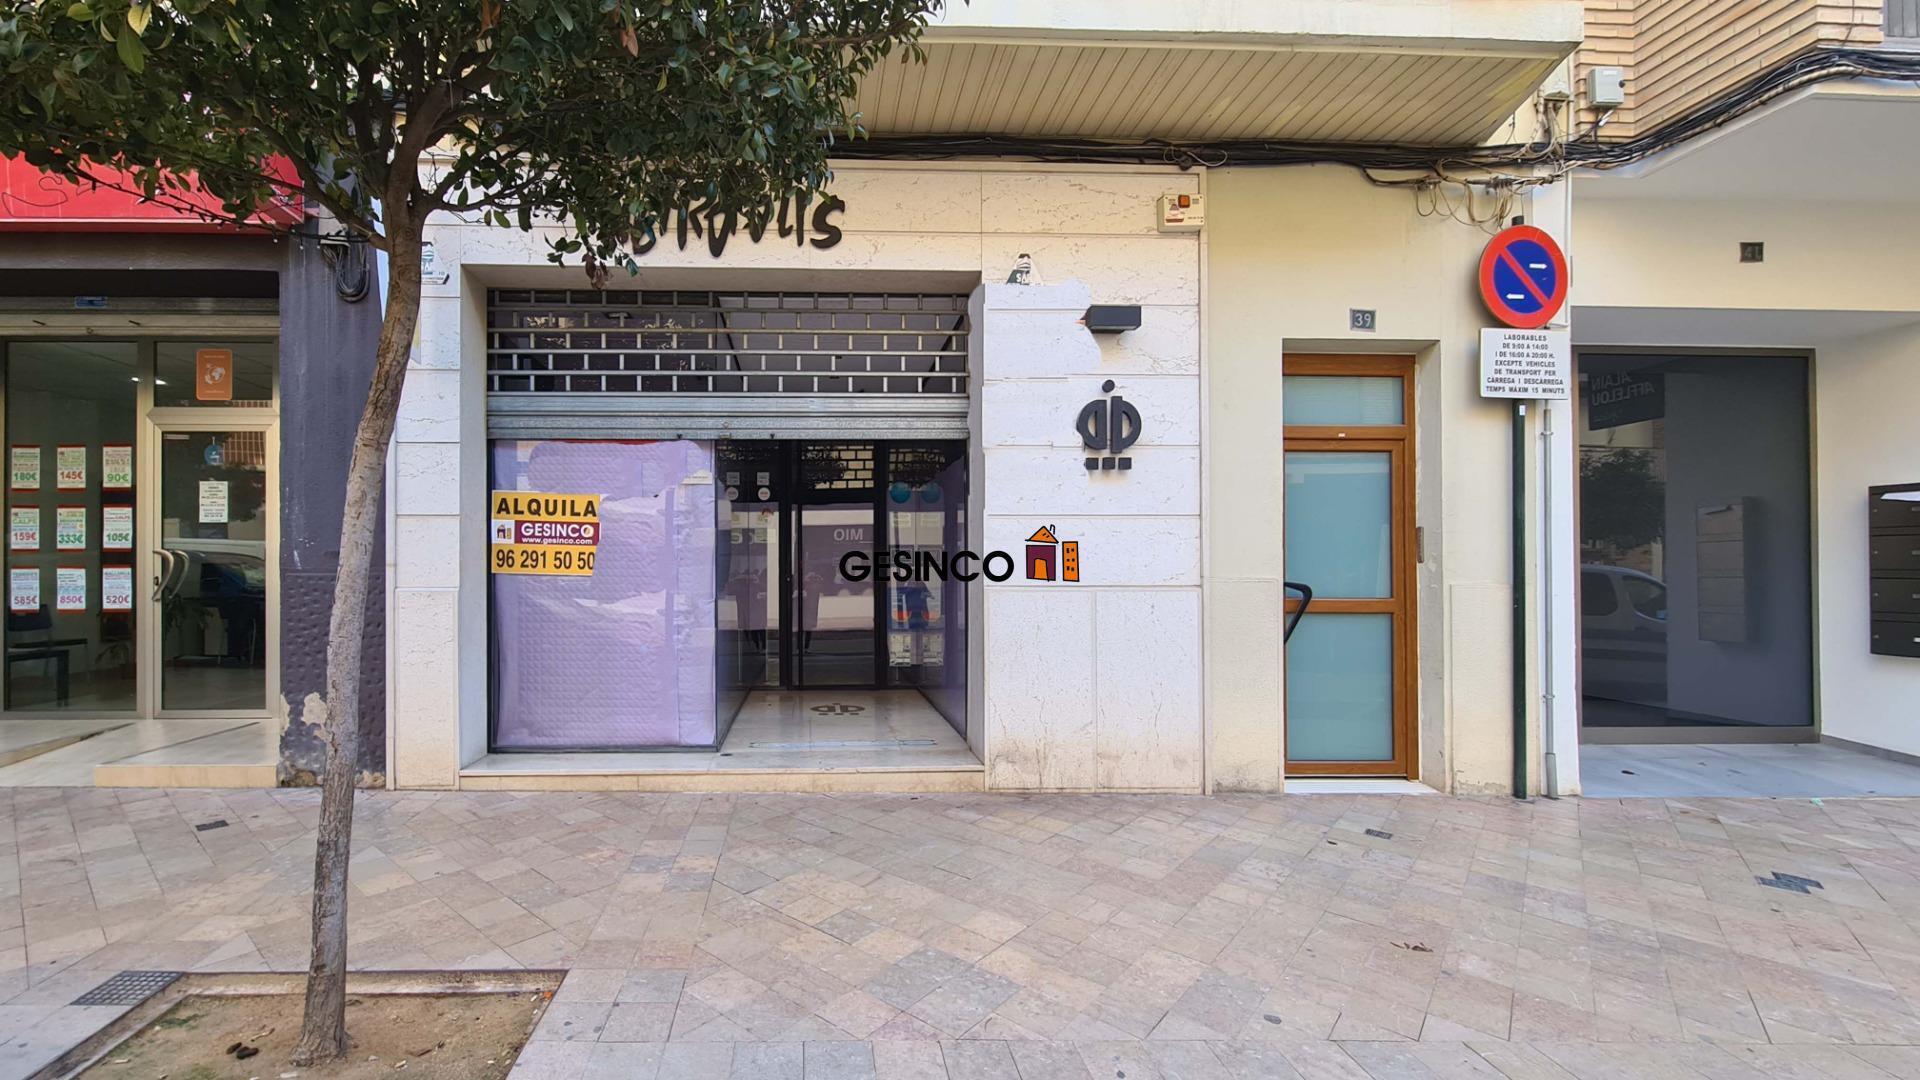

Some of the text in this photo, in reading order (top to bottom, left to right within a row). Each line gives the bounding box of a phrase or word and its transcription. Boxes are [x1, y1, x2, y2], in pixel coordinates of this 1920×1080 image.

[1354, 313, 1371, 327] 39
[14, 472, 37, 481] 180€
[60, 471, 83, 480] 145€
[107, 473, 129, 482] 90€
[496, 498, 597, 517] ALQUILA
[521, 523, 595, 538] GESINCO
[14, 532, 37, 541] 159€
[58, 534, 84, 544] 333€
[106, 533, 130, 542] 105€
[522, 537, 593, 545] www.gesinco.com
[496, 549, 596, 570] 96 291 50 50
[14, 596, 38, 605] 585€
[60, 596, 83, 604] 850€
[106, 595, 130, 604] 520€
